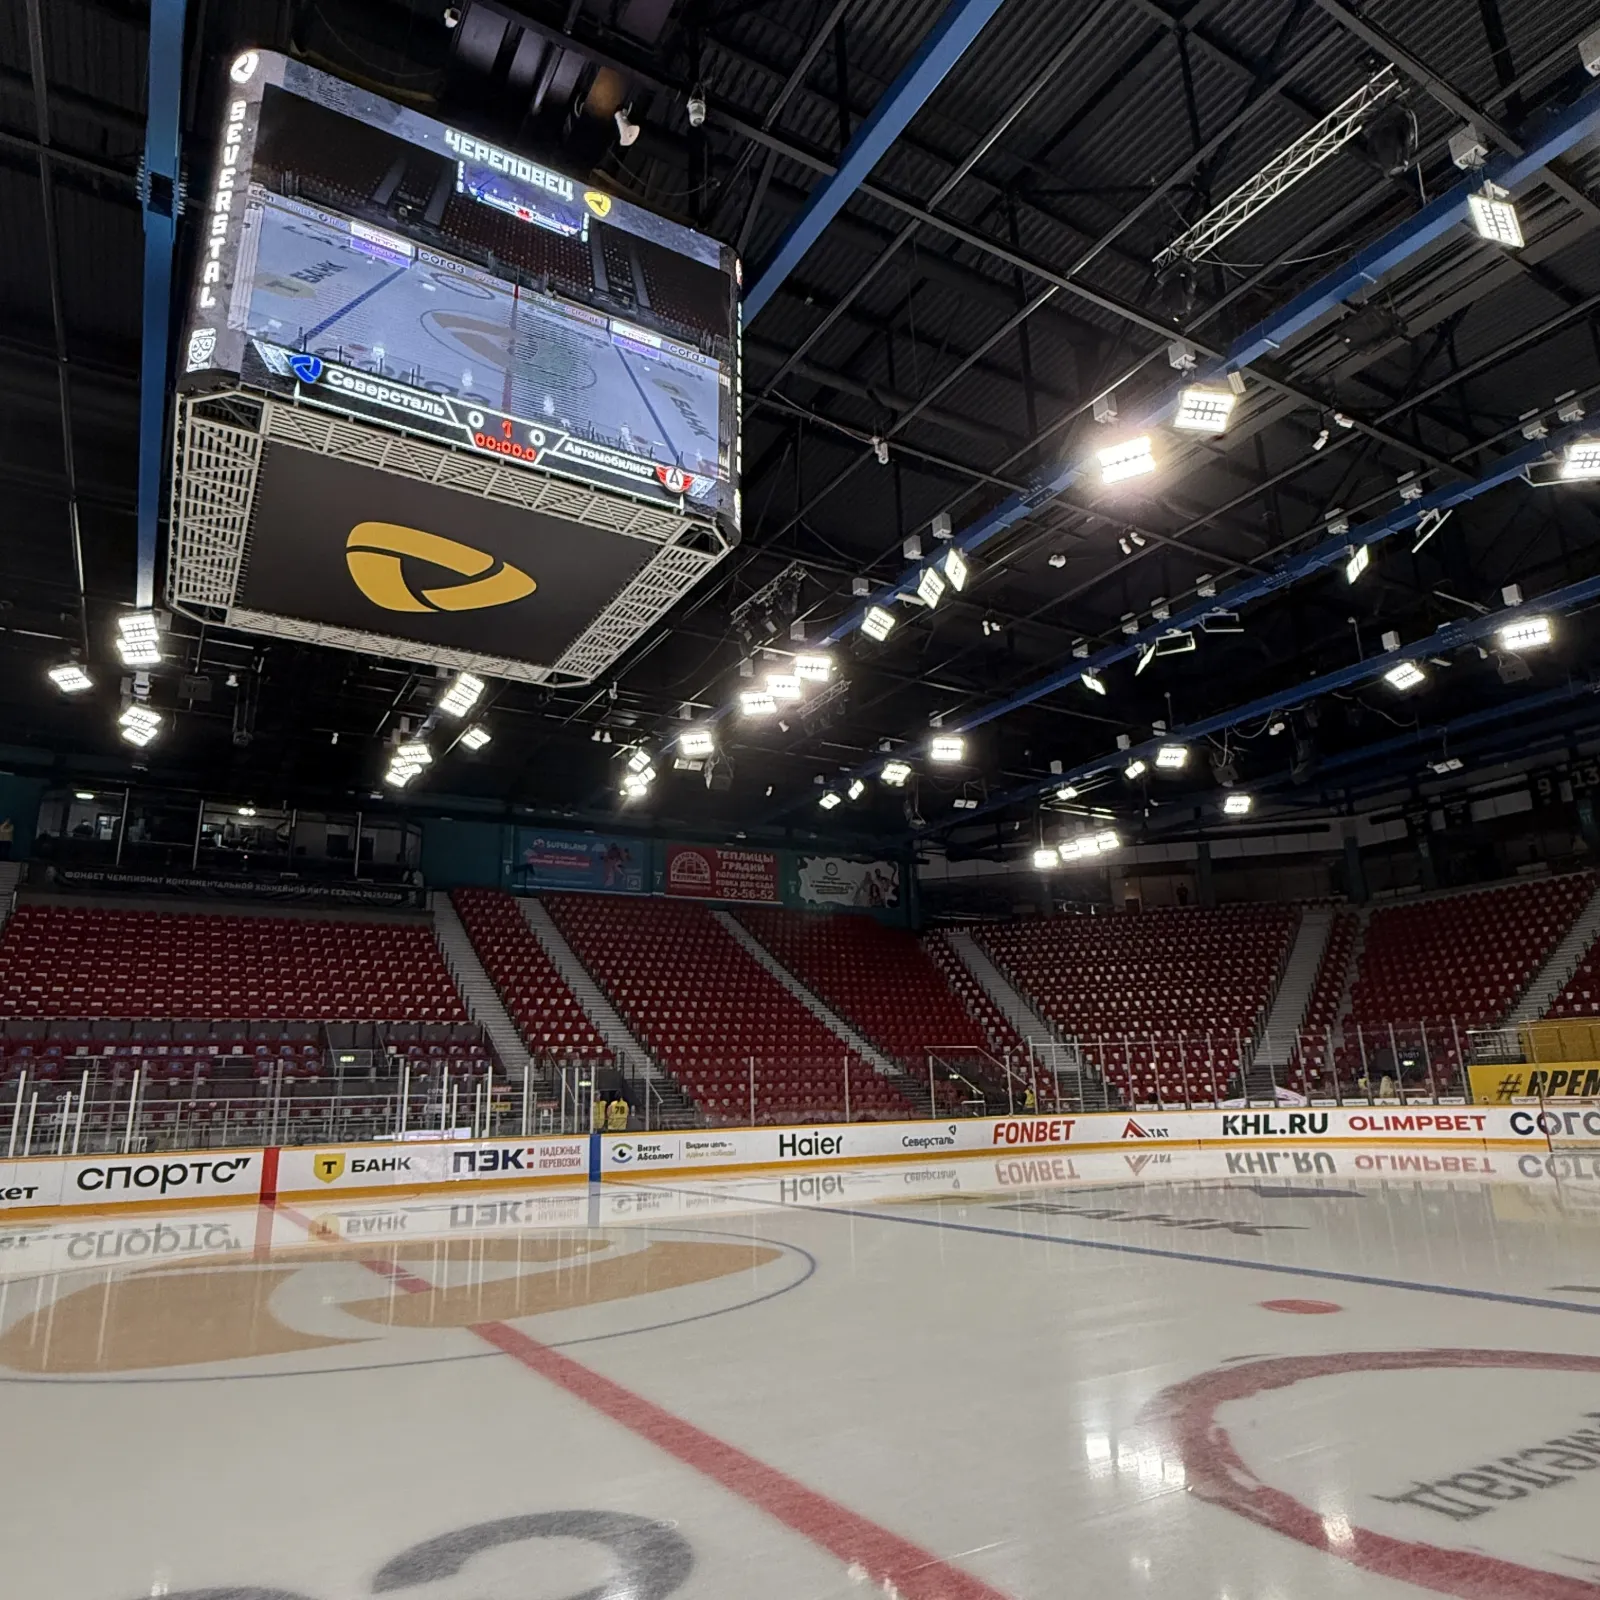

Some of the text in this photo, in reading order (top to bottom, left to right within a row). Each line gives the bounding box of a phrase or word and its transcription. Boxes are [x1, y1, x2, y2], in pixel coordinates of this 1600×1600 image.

[445, 129, 573, 201] ЧЕРЕПОВЕЦ
[200, 100, 246, 308] SEVERSTAL
[326, 370, 445, 417] Северсталь
[467, 410, 485, 428] 0
[502, 420, 513, 438] 1
[529, 429, 546, 447] 0
[475, 432, 536, 461] 00:00.0
[564, 440, 655, 477] Автомобилист
[715, 850, 774, 863] ТЕПЛИЦЫ
[715, 870, 774, 882] ПОЛИКАРБОНАТ
[722, 861, 765, 873] ГРЯДКИ
[65, 871, 104, 880] ФОНБЕТ
[107, 873, 163, 884] ЧЕМПИОНАТ
[166, 877, 253, 890] КОНТИНЕНТАЛЬНОЙ
[255, 884, 306, 893] ХОККЕЙНОЙ
[307, 886, 329, 895] ЛИГИ
[330, 888, 361, 898] СЕЗОНА
[723, 887, 774, 900] 52-56-52
[993, 1119, 1076, 1144] FONBET
[1222, 1112, 1329, 1136] KHL.RU
[1348, 1115, 1487, 1131] OLIMPBET
[539, 1145, 581, 1157] НАДЕЖНЫЕ
[637, 1144, 661, 1153] Визус
[779, 1131, 843, 1157] Haier
[902, 1135, 955, 1149] Северсталь
[351, 1156, 412, 1173] БАНК
[538, 1157, 581, 1169] ПЕРЕВОЗКИ
[637, 1152, 674, 1161] Абсолют
